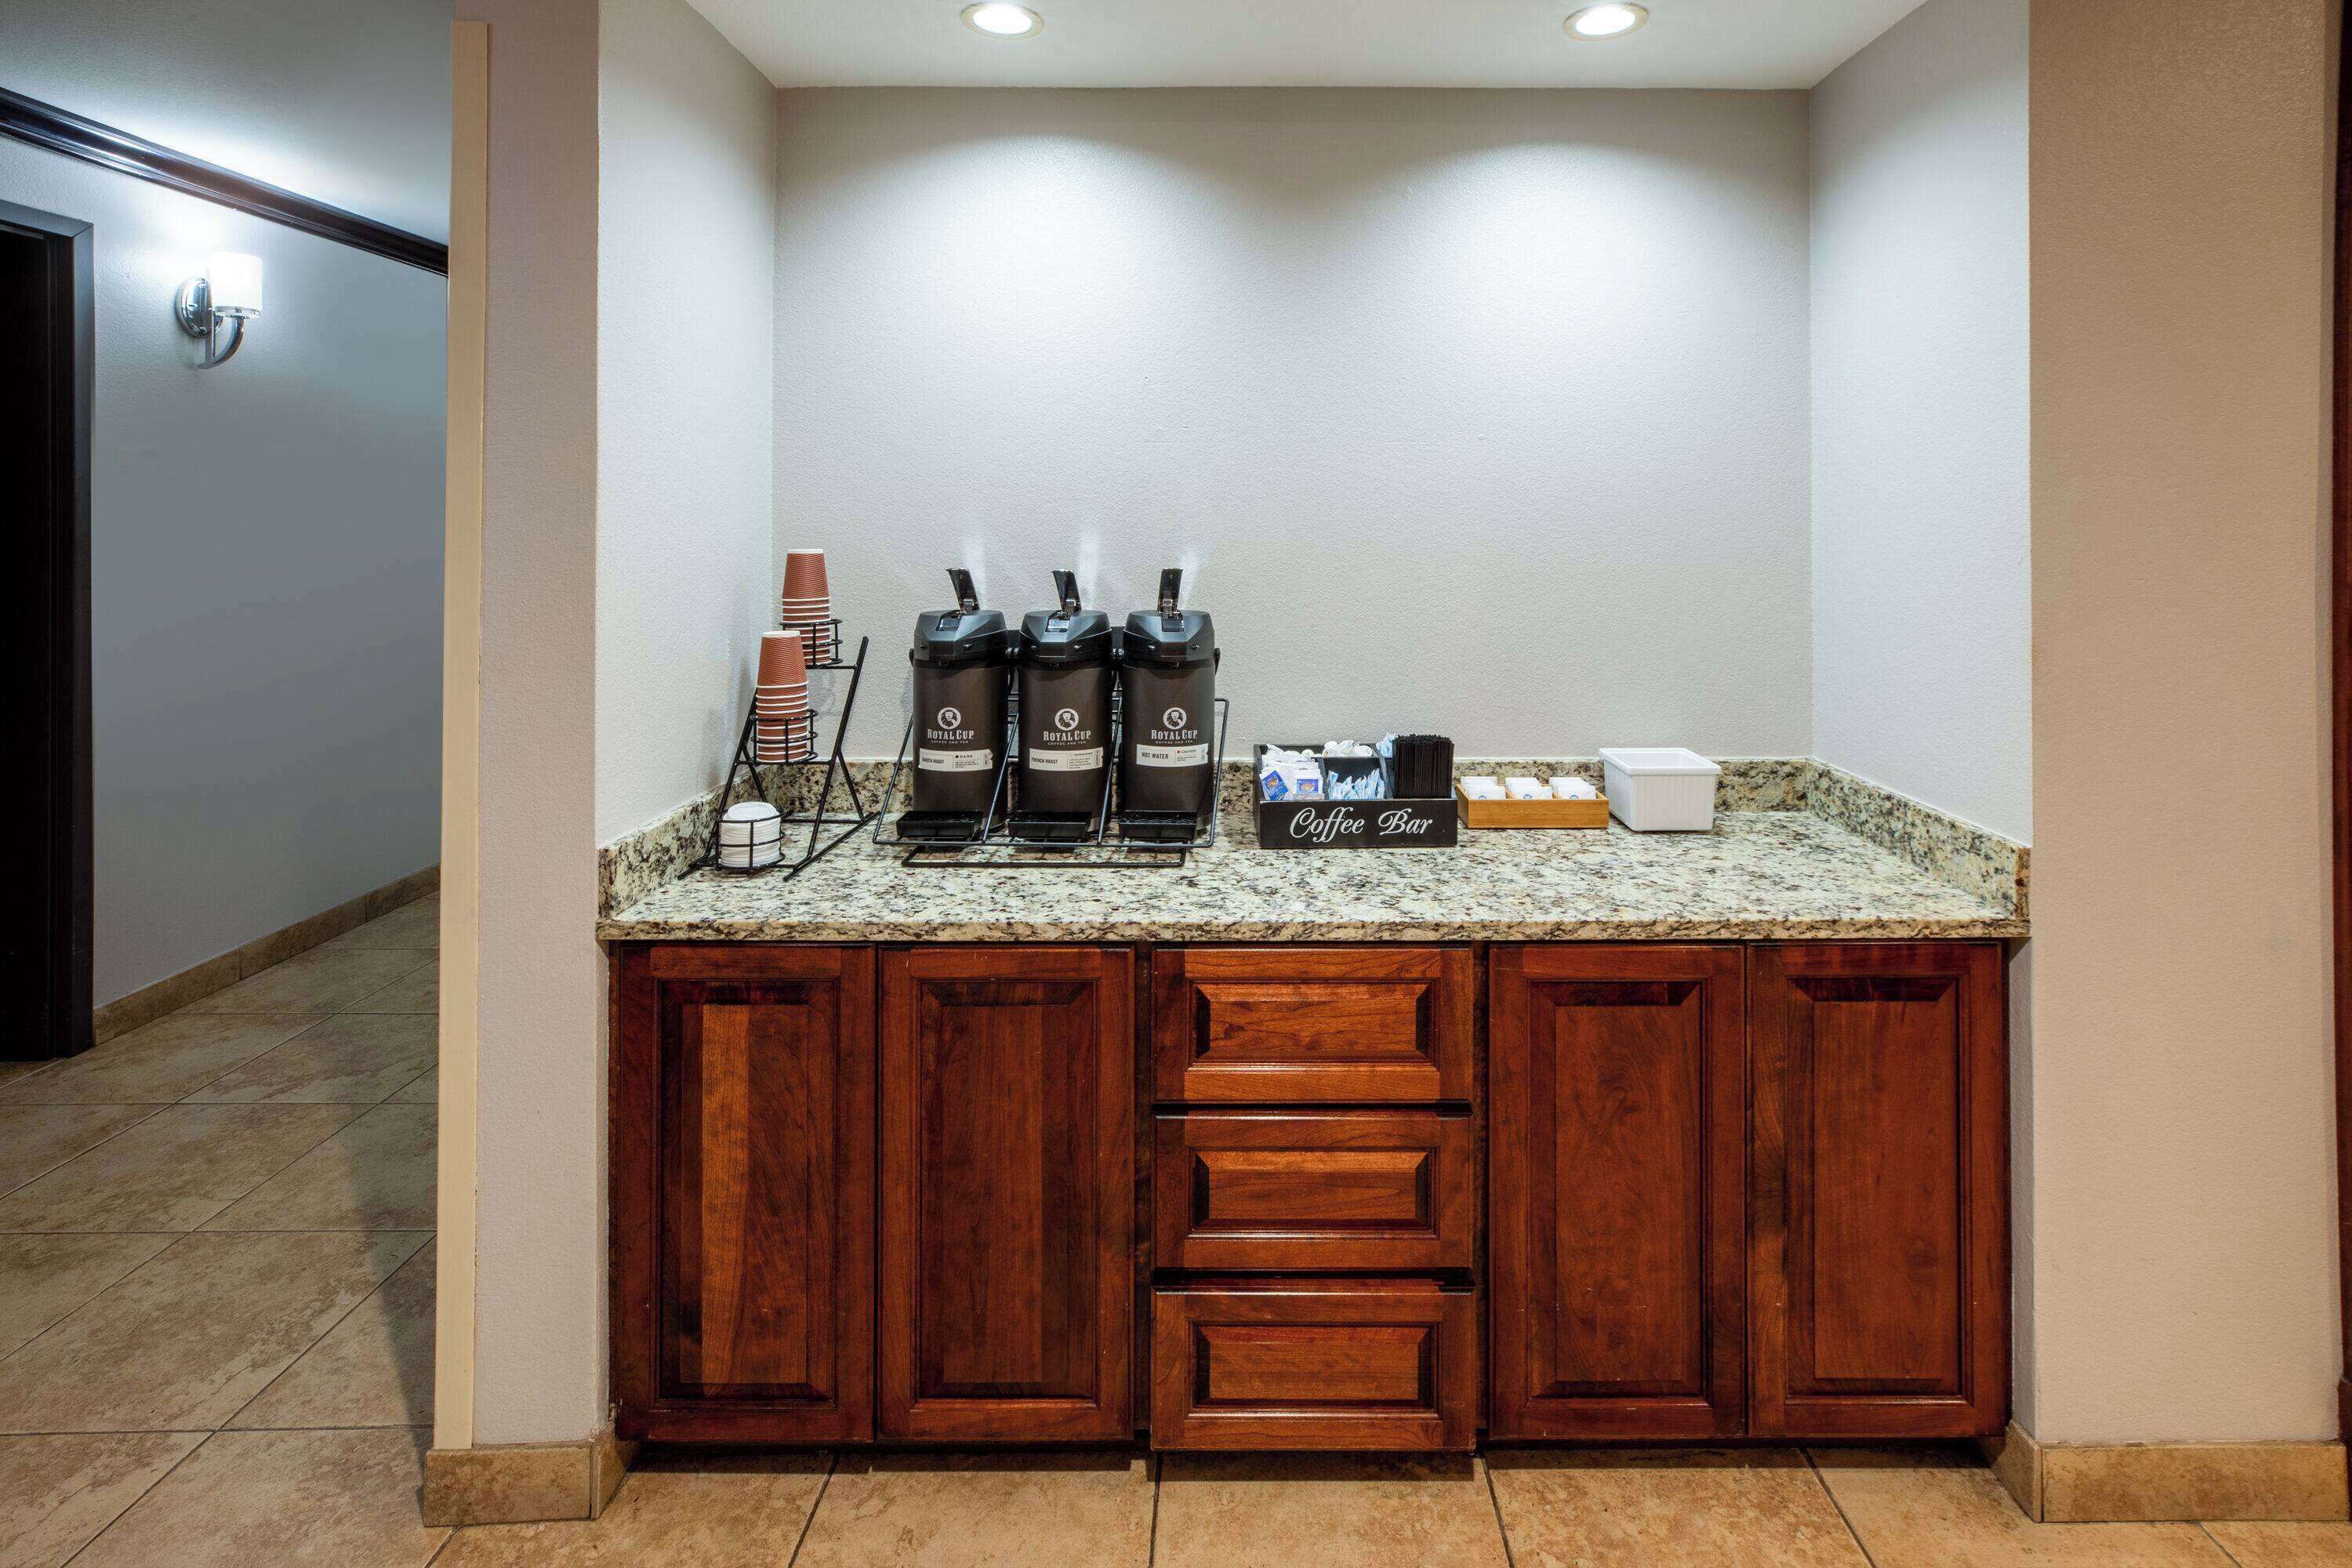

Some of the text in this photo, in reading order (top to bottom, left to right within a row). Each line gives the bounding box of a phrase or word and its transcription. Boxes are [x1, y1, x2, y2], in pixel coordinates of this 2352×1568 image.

[927, 728, 975, 740] ROYAL CUP
[1043, 730, 1091, 742] ROYAL CUP
[1151, 729, 1198, 740] ROYAL CUP
[1290, 807, 1433, 843] Coffee Bar
